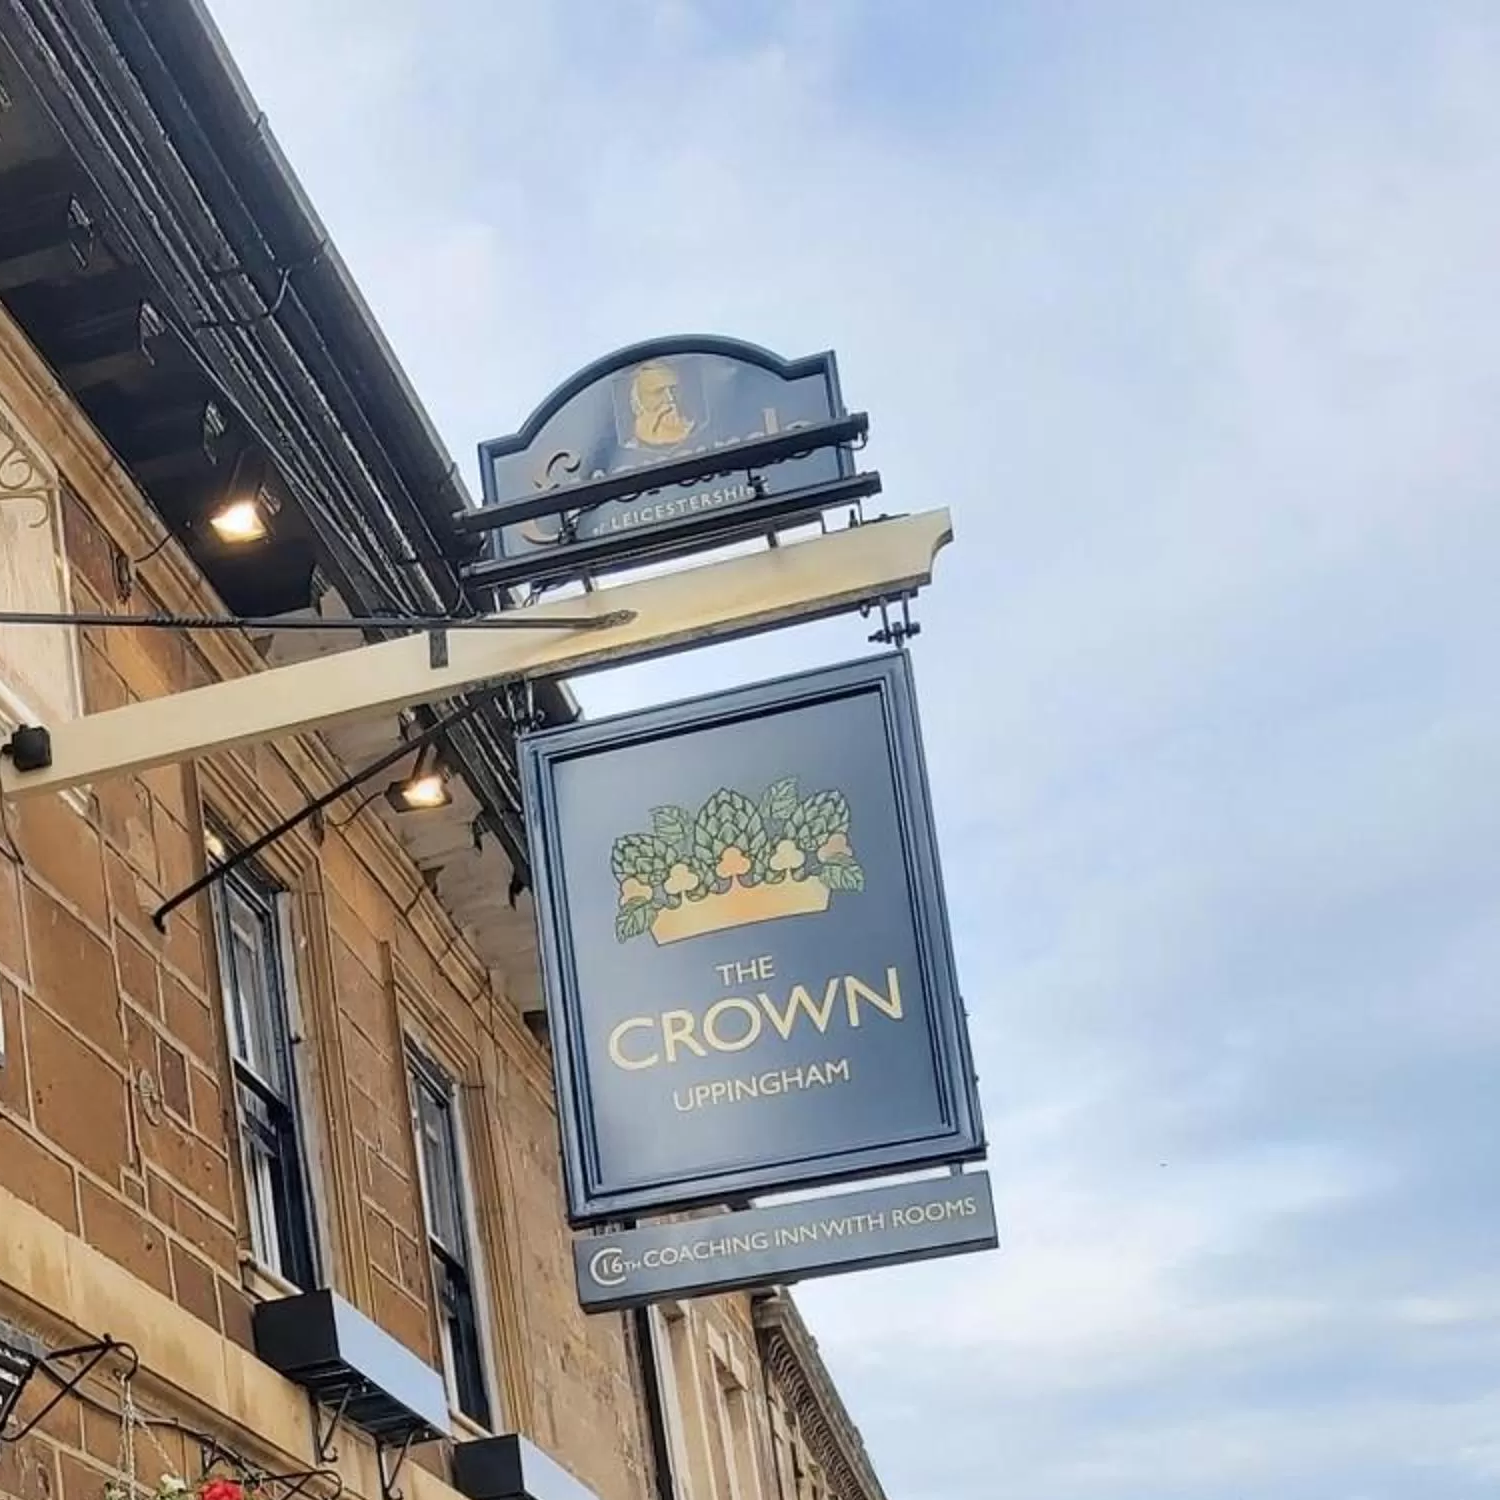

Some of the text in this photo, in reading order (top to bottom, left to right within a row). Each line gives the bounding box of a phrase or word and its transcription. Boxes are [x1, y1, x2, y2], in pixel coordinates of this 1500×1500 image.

[715, 955, 776, 986] THE
[608, 966, 905, 1072] CROWN
[672, 1058, 851, 1113] UPPINGHAM
[643, 1230, 770, 1268] COACHING
[774, 1221, 818, 1247] INN
[817, 1211, 885, 1238] WITH
[891, 1197, 978, 1228] ROOMS
